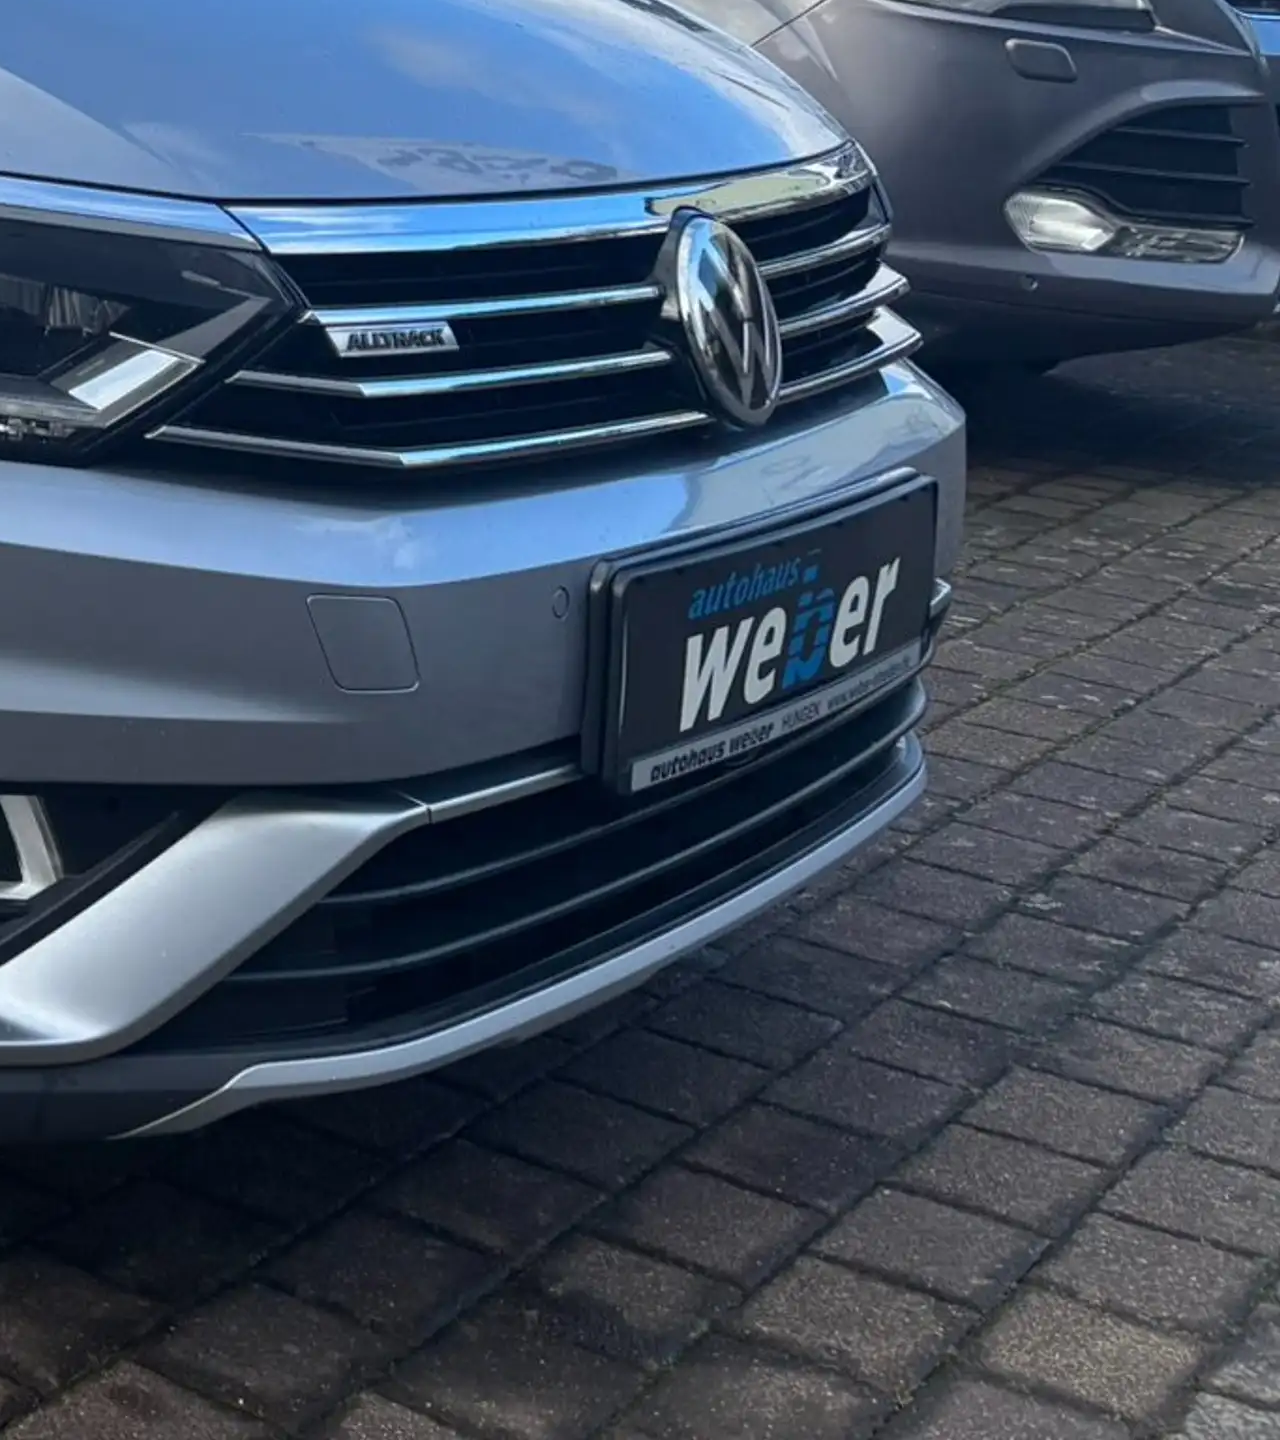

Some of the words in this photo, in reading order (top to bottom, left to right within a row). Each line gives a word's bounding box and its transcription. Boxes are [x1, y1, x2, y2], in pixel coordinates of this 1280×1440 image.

[688, 557, 802, 621] autohaus
[679, 549, 900, 733] weber
[650, 740, 725, 783] autohaus
